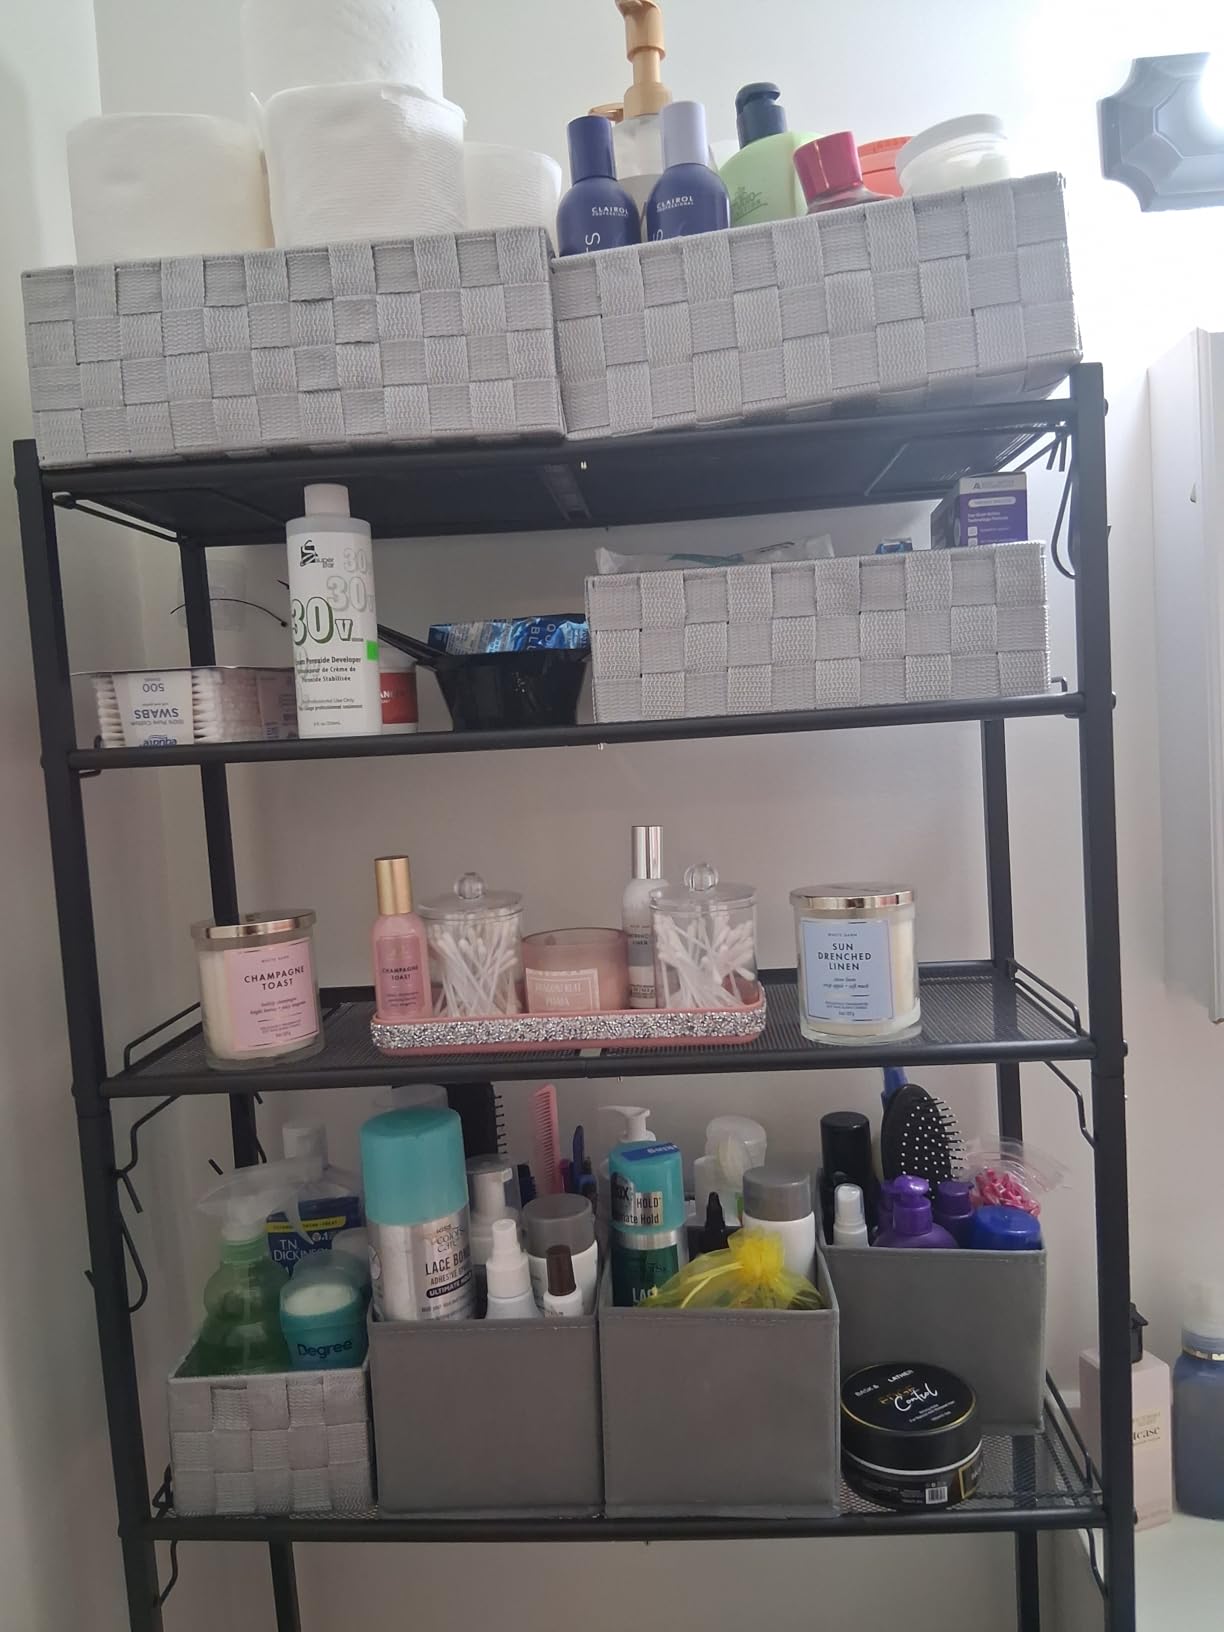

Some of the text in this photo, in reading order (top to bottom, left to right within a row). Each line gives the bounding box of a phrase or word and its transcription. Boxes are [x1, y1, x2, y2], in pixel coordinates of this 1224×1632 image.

[656, 195, 694, 208] CLAIROL
[591, 206, 629, 215] CLAIROL
[331, 656, 361, 665] Developer
[142, 682, 165, 693] 500
[134, 707, 179, 719] SWABS
[832, 943, 854, 951] SUN
[817, 952, 872, 960] DRENCHED
[382, 964, 418, 973] CHAMPAGNE
[828, 962, 860, 971] LINEN
[244, 965, 304, 983] CHAMPAGNE
[262, 977, 293, 990] TOAST
[636, 1197, 659, 1209] HOLD
[640, 1213, 659, 1224] Hold
[425, 1256, 451, 1275] LACE
[430, 1270, 458, 1286] ADHESIVE
[429, 1280, 460, 1297] ULTIMATE
[297, 1339, 353, 1359] Degree
[894, 1383, 938, 1412] Control
